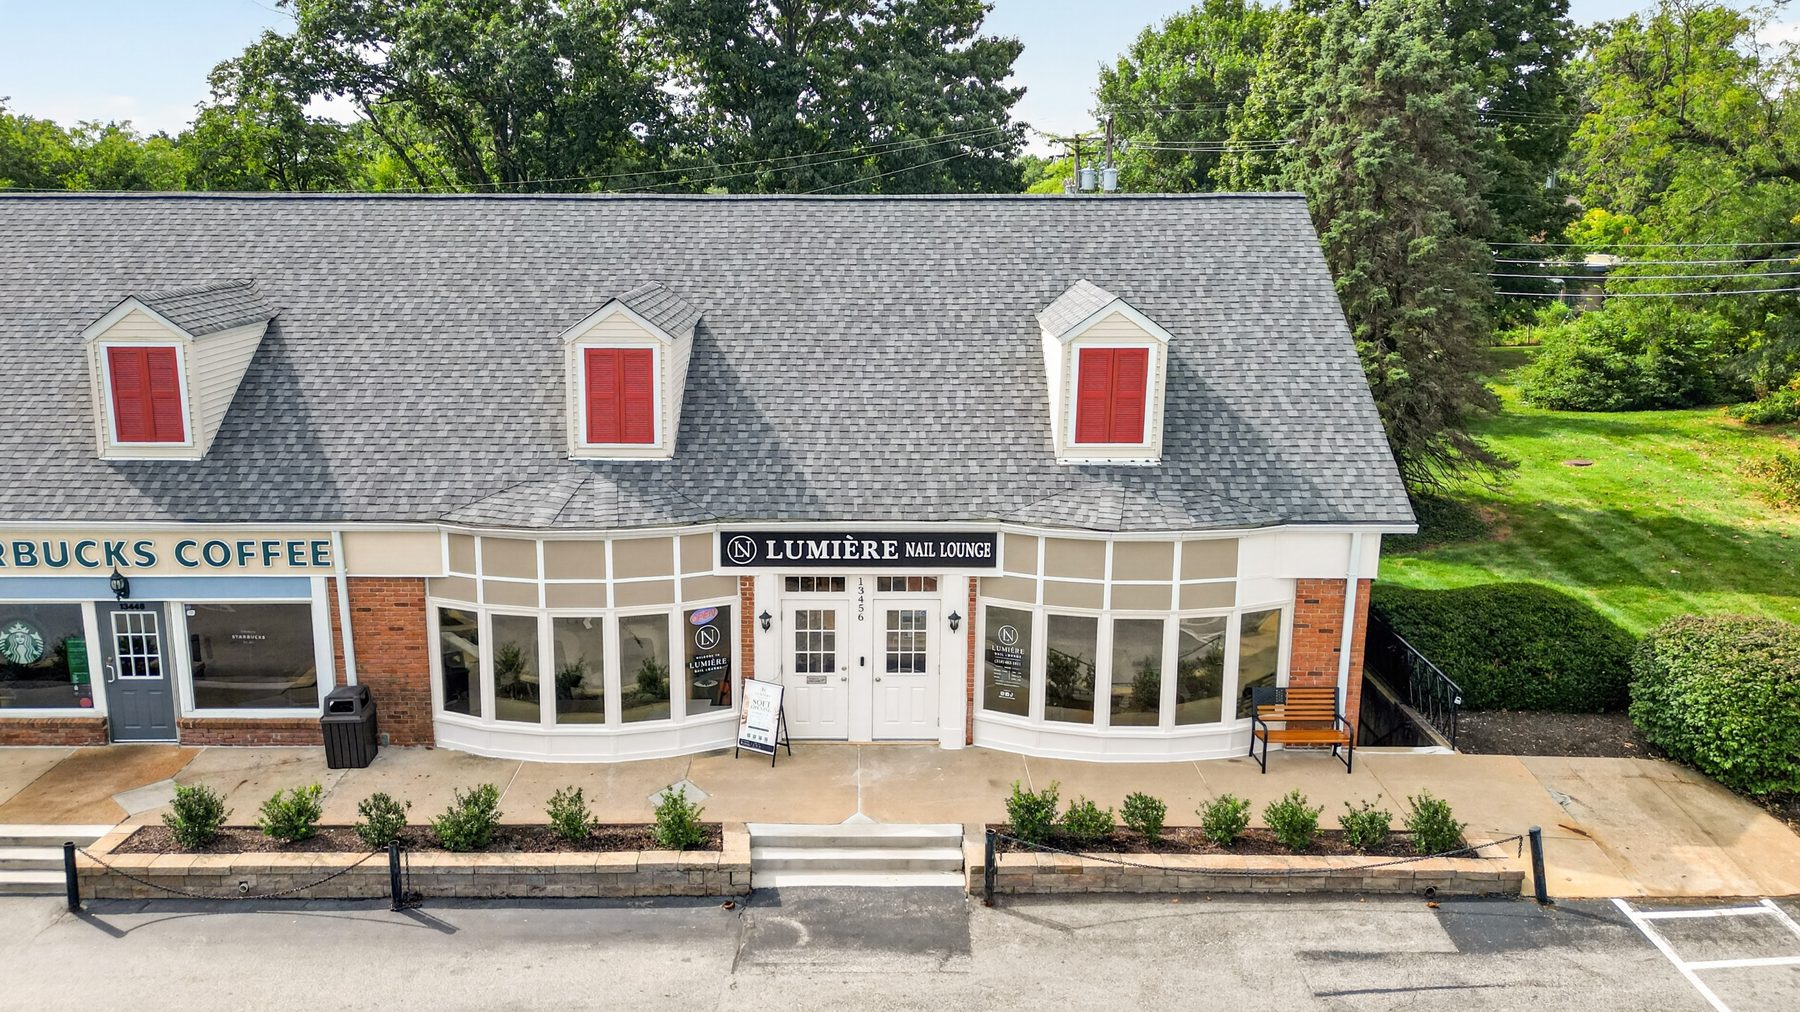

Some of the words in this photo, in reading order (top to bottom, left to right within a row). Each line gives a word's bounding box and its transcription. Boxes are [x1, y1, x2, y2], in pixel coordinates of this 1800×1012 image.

[173, 538, 333, 568] COFFEE
[766, 534, 899, 560] LUMIÈRE
[904, 542, 936, 558] NAIL
[939, 542, 991, 558] LOUNGE
[857, 577, 865, 622] 13456
[691, 607, 718, 623] OPEN
